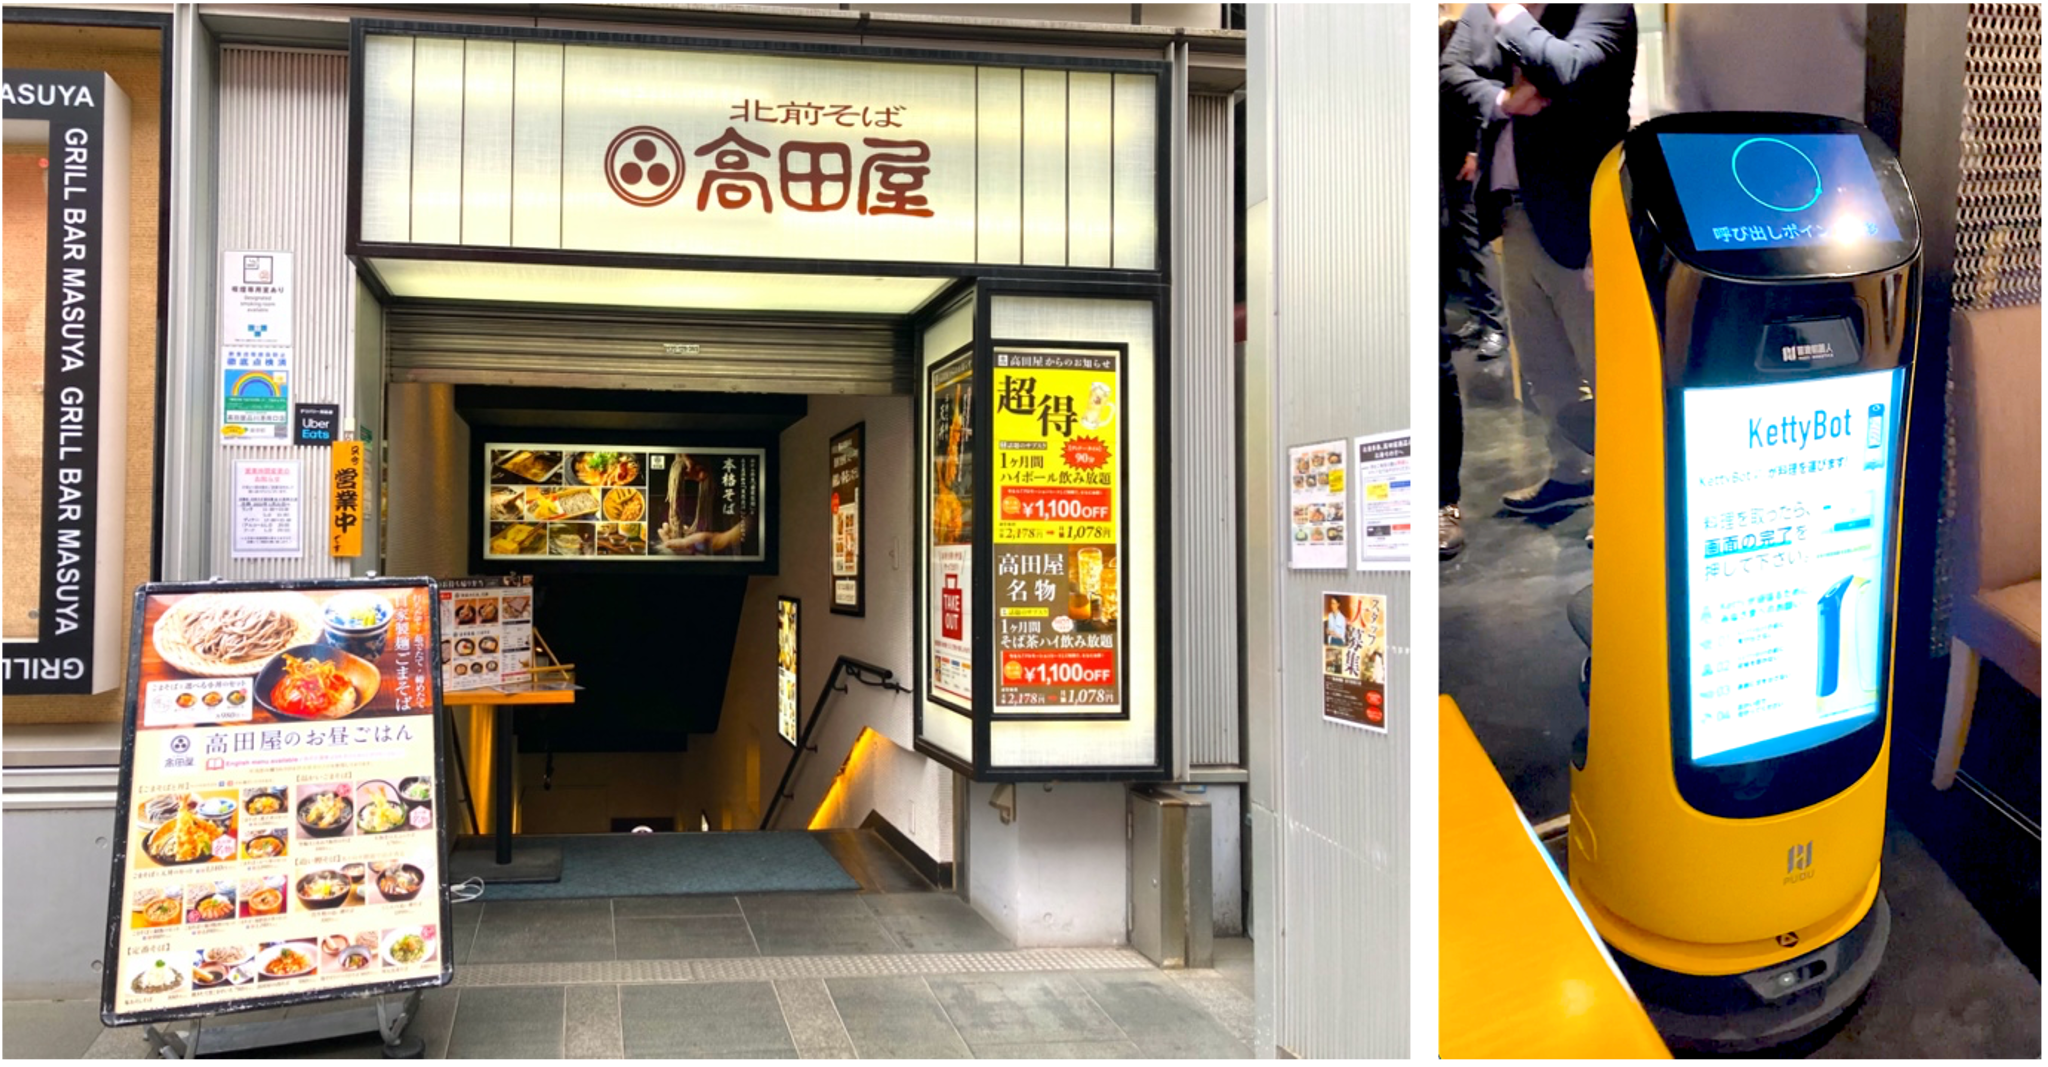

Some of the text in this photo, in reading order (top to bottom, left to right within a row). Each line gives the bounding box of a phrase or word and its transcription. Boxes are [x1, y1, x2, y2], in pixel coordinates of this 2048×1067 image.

[729, 98, 907, 128] 北前そば
[694, 126, 936, 218] 高田屋
[1009, 355, 1111, 369] 高田屋からのお知らせ
[55, 128, 89, 636] GRILL BAR MASUYA GRILL BAR MASUYA
[997, 375, 1078, 438] 超得
[302, 418, 331, 429] Uber
[302, 429, 331, 439] Eats
[1749, 408, 1852, 451] KettyBot
[721, 457, 737, 516] 本格そば
[1000, 471, 1112, 485] ハイボール飲み放題
[334, 467, 359, 535] 営業中
[1704, 524, 1806, 556] 画面の完了を
[998, 553, 1065, 577] 高田屋
[1006, 579, 1057, 602] 名物
[943, 593, 960, 612] TAKE
[944, 612, 959, 631] OUT
[1001, 634, 1114, 649] そば茶ハイ飲み放題
[205, 724, 414, 755] 高田屋のお昼ごはん
[270, 757, 298, 765] available
[1783, 869, 1815, 886] PUDU
